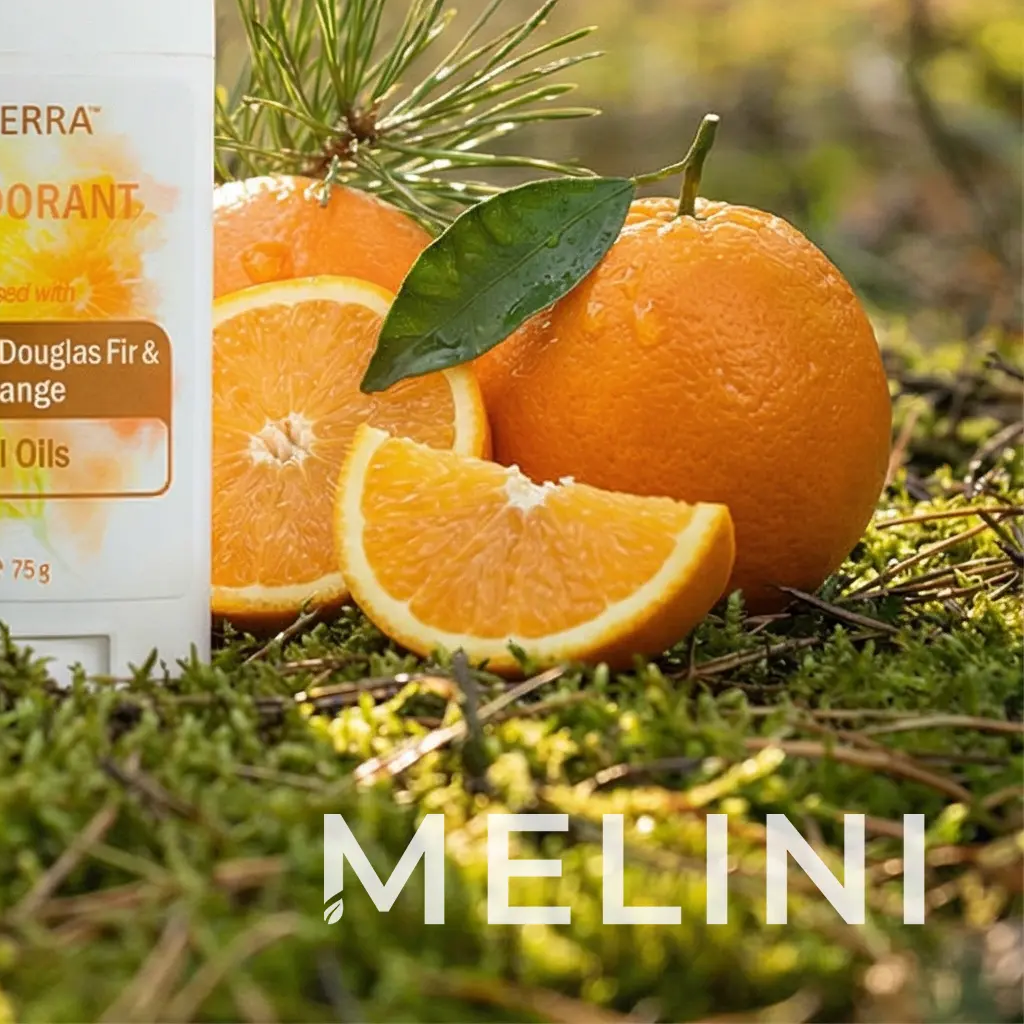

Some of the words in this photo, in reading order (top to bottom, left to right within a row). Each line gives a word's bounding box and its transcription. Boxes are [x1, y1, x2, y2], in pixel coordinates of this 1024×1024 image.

[35, 282, 76, 303] with
[106, 338, 139, 365] Fir
[141, 340, 161, 365] &
[15, 437, 71, 469] Oils
